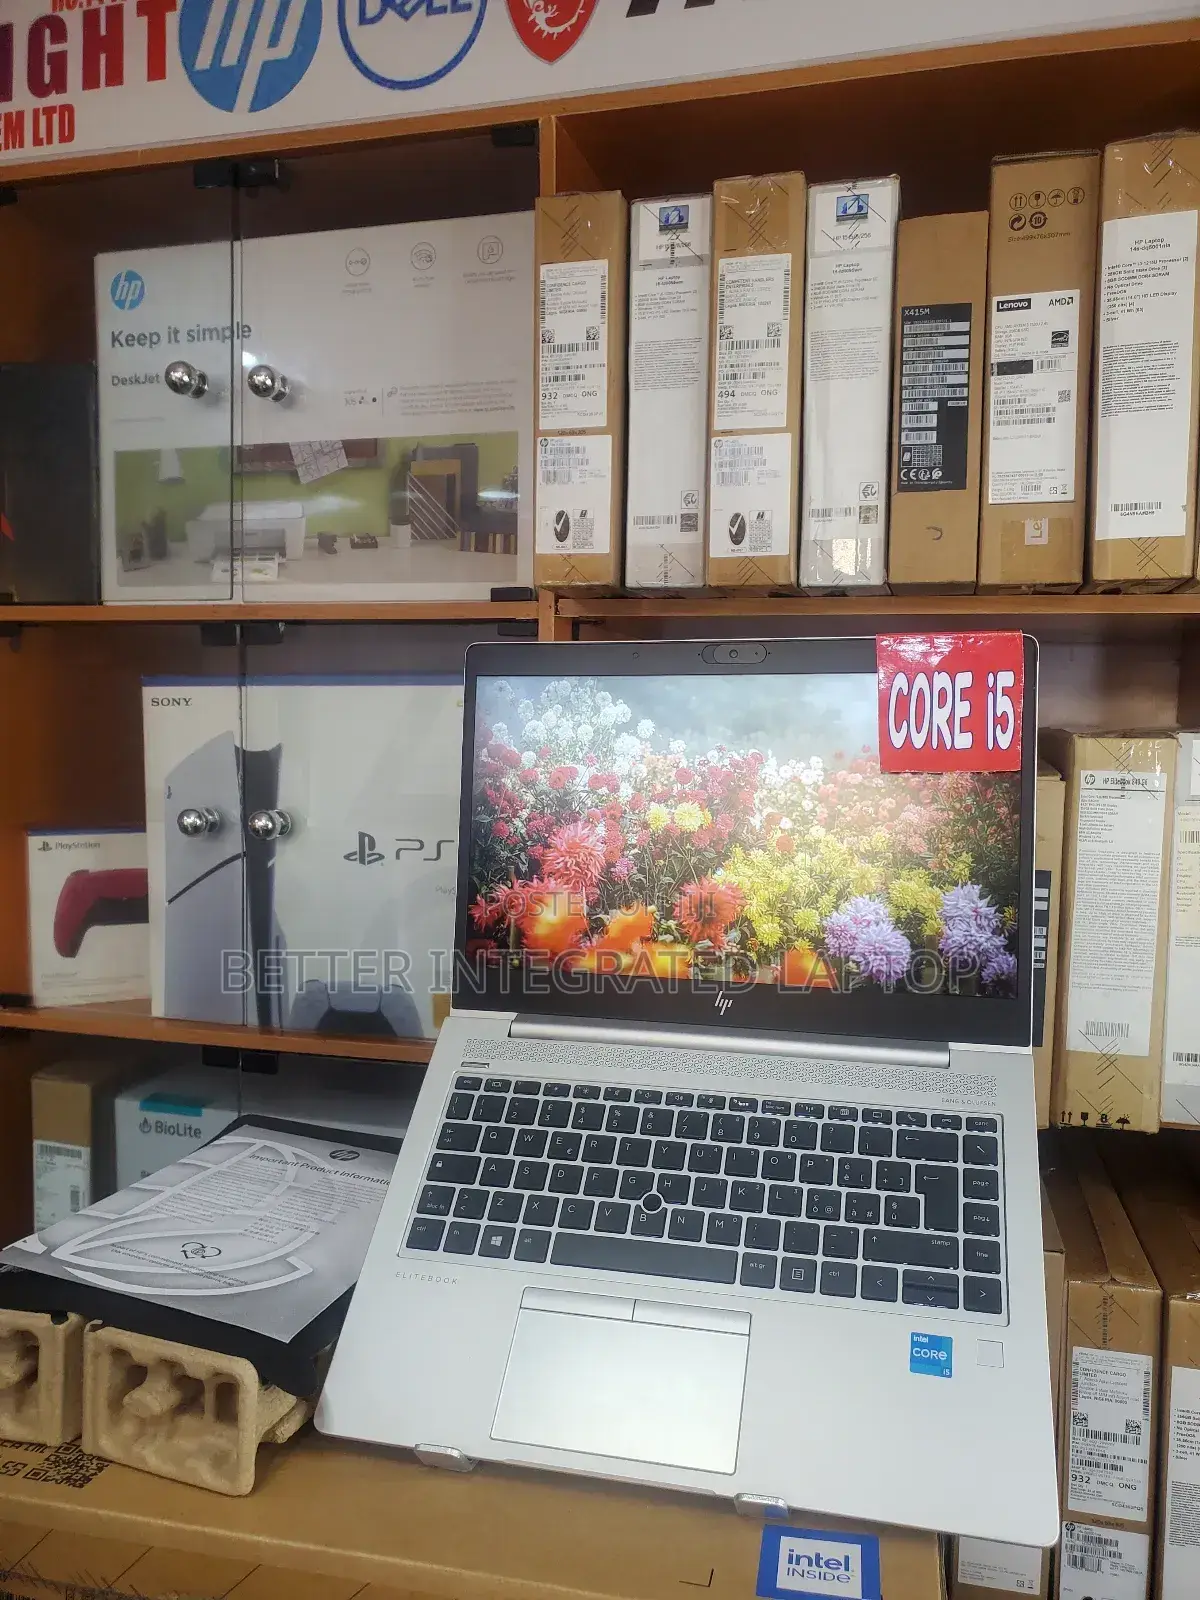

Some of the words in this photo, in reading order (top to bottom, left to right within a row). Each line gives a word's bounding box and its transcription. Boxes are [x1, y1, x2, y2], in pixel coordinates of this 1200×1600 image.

[0, 110, 25, 151] M
[33, 104, 75, 147] LTD
[114, 271, 142, 311] hp
[999, 301, 1029, 309] Lenovo
[1048, 298, 1067, 307] AMD
[904, 308, 930, 316] X415M
[111, 330, 161, 348] Keep
[168, 325, 180, 344] it
[187, 321, 252, 343] simple
[112, 373, 160, 387] DeskJet
[541, 392, 558, 400] 932
[718, 390, 736, 399] 494
[761, 389, 778, 397] ONG
[150, 698, 192, 707] SONY
[888, 670, 973, 750] CORE
[987, 670, 1015, 751] i5
[56, 841, 100, 851] PlayStation
[154, 1120, 202, 1139] BioLite
[590, 1140, 597, 1148] R
[662, 1146, 669, 1154] Y
[250, 1154, 300, 1167] Important
[300, 1162, 340, 1175] Product
[807, 1160, 814, 1168] P
[524, 1167, 530, 1175] S
[558, 1170, 565, 1178] D
[592, 1173, 599, 1181] F
[664, 1180, 672, 1188] H
[738, 1188, 745, 1196] K
[776, 1191, 782, 1199] L
[497, 1198, 504, 1206] Z
[532, 1202, 540, 1210] X
[568, 1205, 575, 1213] C
[604, 1208, 612, 1216] V
[640, 1214, 647, 1222] B
[678, 1216, 685, 1225] N
[716, 1220, 724, 1228] M
[396, 1272, 458, 1285] ELITEBOOK
[914, 1335, 929, 1343] intel
[1072, 1474, 1090, 1484] 932
[1119, 1483, 1137, 1491] ONG
[788, 1548, 850, 1572] intel
